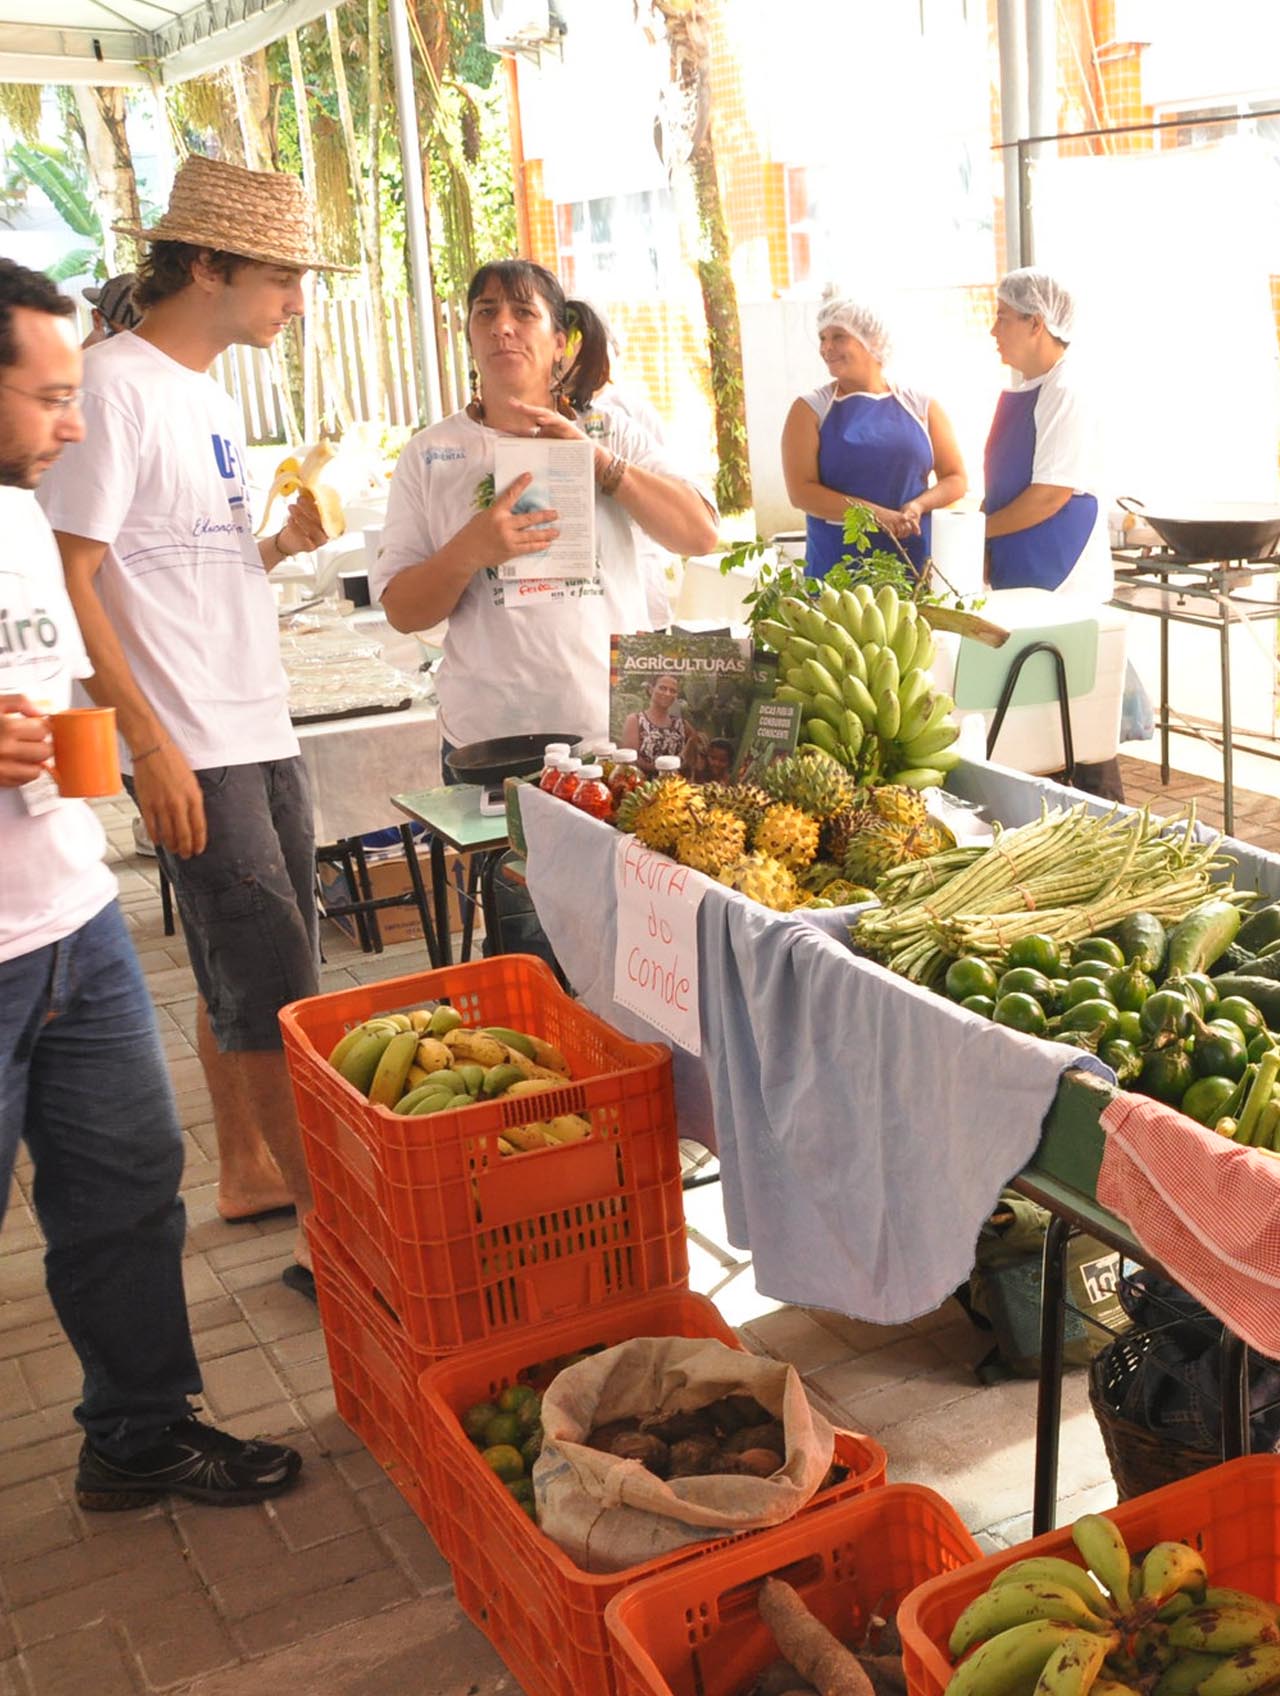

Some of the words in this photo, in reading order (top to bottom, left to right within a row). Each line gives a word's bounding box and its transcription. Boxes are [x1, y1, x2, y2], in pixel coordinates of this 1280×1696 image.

[623, 653, 746, 673] AGRICULTURAS
[622, 840, 690, 896] FRUTA
[648, 901, 673, 945] do
